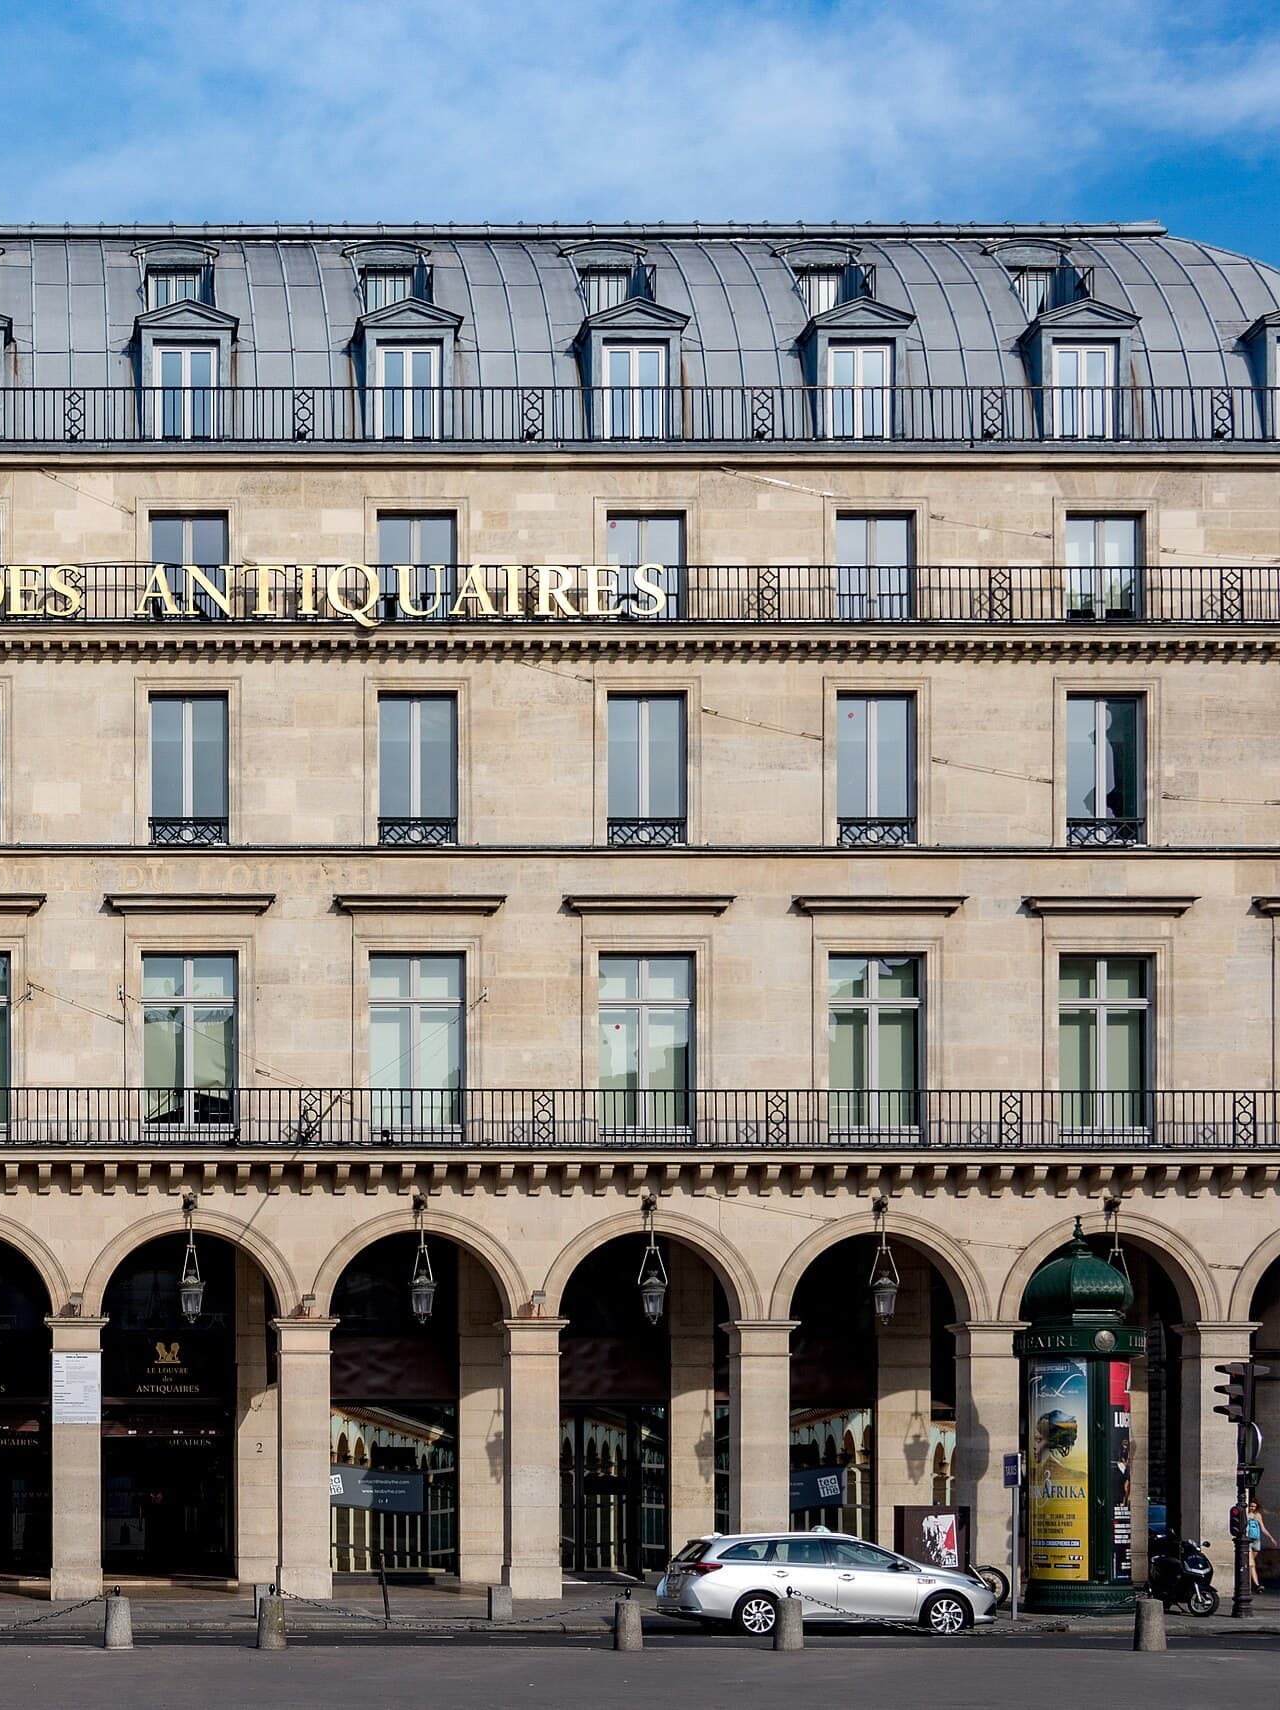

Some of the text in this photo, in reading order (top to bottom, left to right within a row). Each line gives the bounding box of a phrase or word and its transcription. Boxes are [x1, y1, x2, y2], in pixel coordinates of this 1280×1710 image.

[133, 562, 667, 628] ANTIQUAIRES
[120, 863, 172, 891] DU
[136, 1385, 200, 1393] ANTIQUAIRES
[256, 1442, 263, 1453] 2
